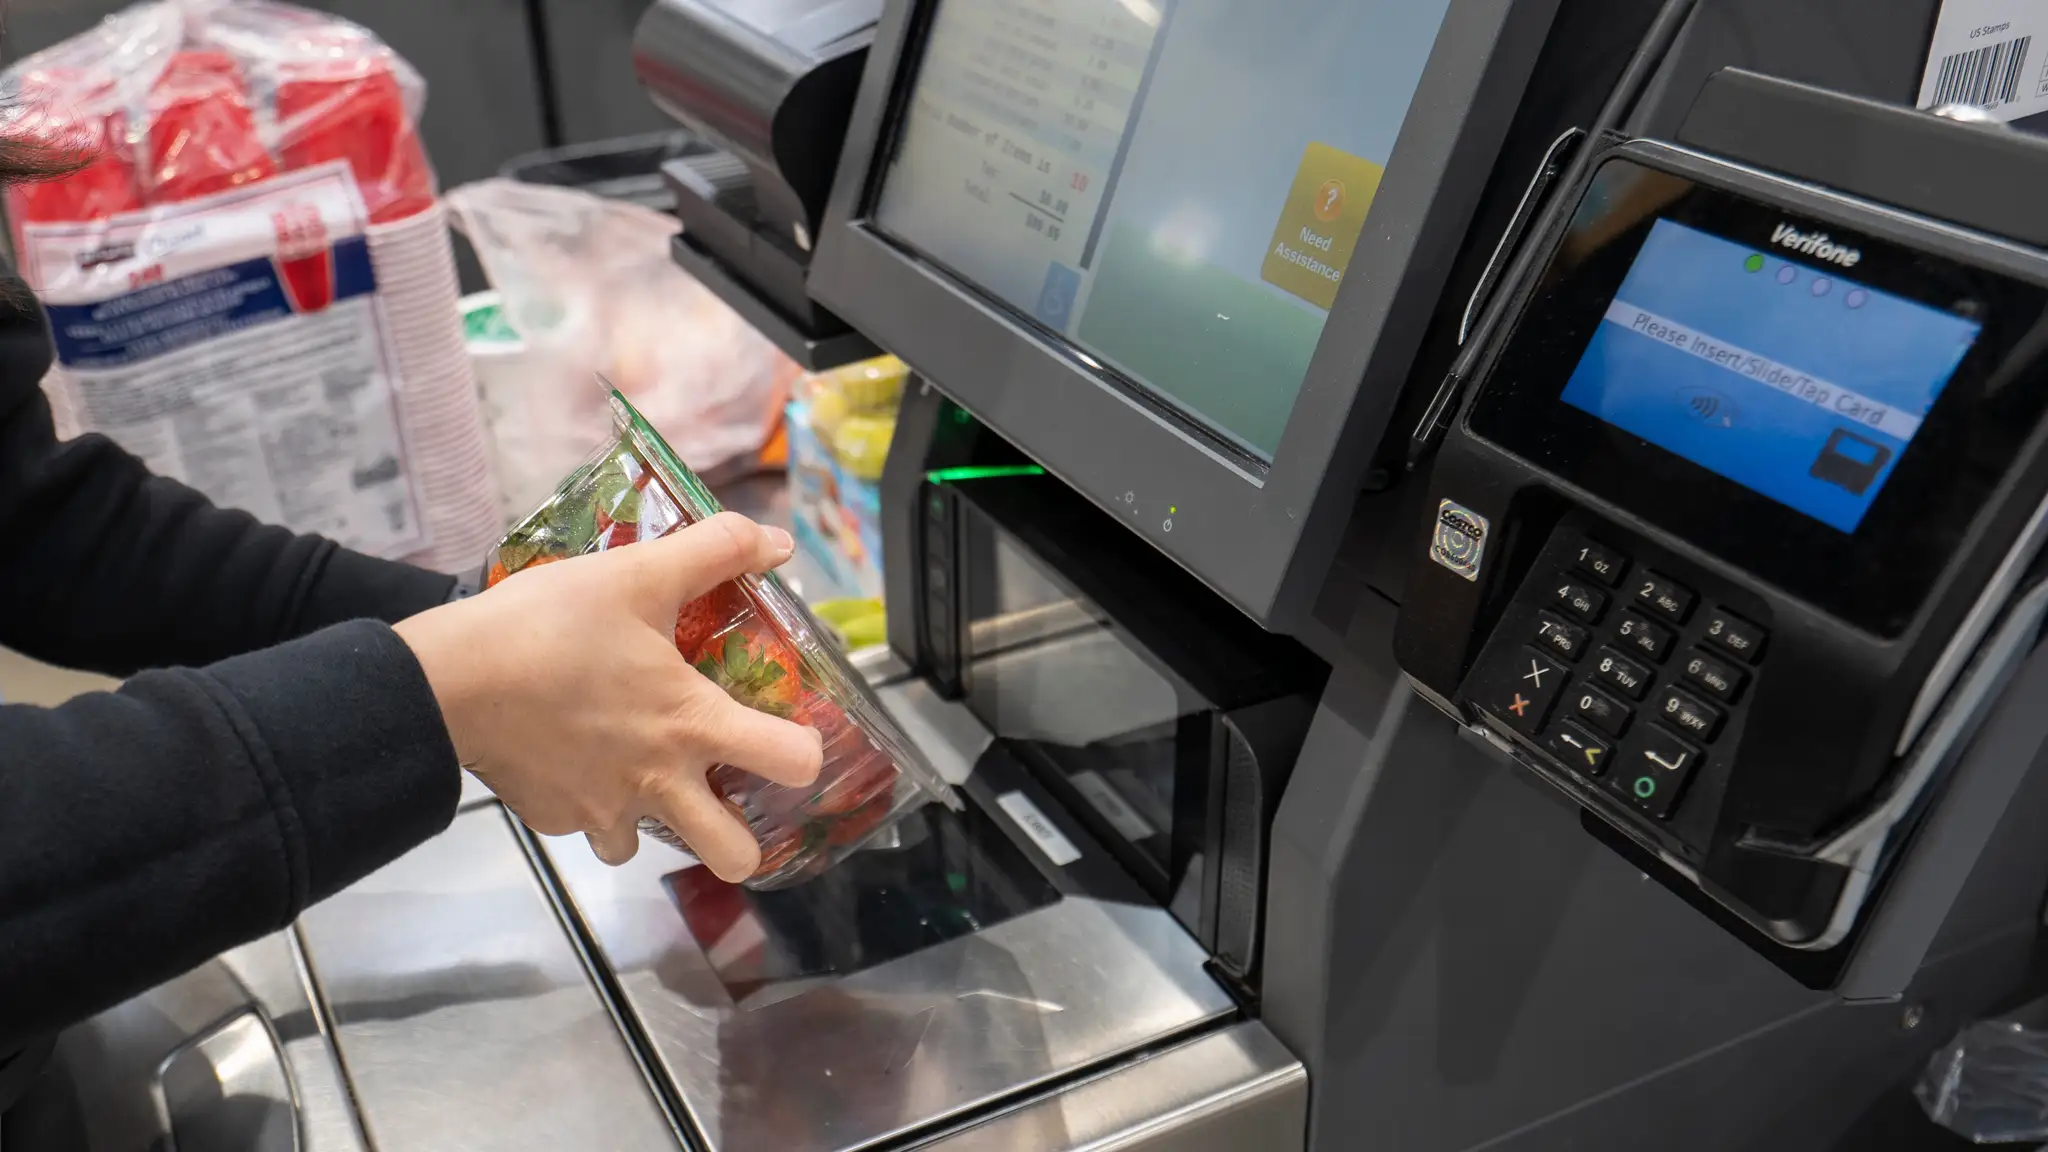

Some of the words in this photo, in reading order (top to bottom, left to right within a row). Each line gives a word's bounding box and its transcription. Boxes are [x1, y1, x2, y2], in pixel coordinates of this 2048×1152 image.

[1970, 27, 1981, 39] US
[1982, 21, 2010, 36] Stamps
[1299, 226, 1333, 252] Need
[1770, 221, 1861, 267] Verifone
[1274, 242, 1340, 282] Assistance
[1632, 312, 1688, 347] Please
[1690, 335, 1831, 405] Insert/Slide/Tap
[1834, 394, 1888, 426] Card
[1579, 547, 1590, 561] 1
[1557, 585, 1570, 599] 4
[1640, 582, 1655, 598] 2
[1573, 598, 1591, 612] GHI
[1656, 595, 1679, 612] ABC
[1540, 621, 1551, 634] 7
[1619, 620, 1634, 635] 5
[1709, 619, 1724, 635] 3
[1637, 635, 1656, 651] JKL
[1726, 633, 1749, 650] DEF
[1600, 657, 1613, 672] 8
[1687, 658, 1704, 674] 6
[1615, 671, 1637, 688] TUV
[1704, 672, 1728, 691] MNO
[1580, 695, 1593, 709] 0
[1665, 698, 1680, 713] 9
